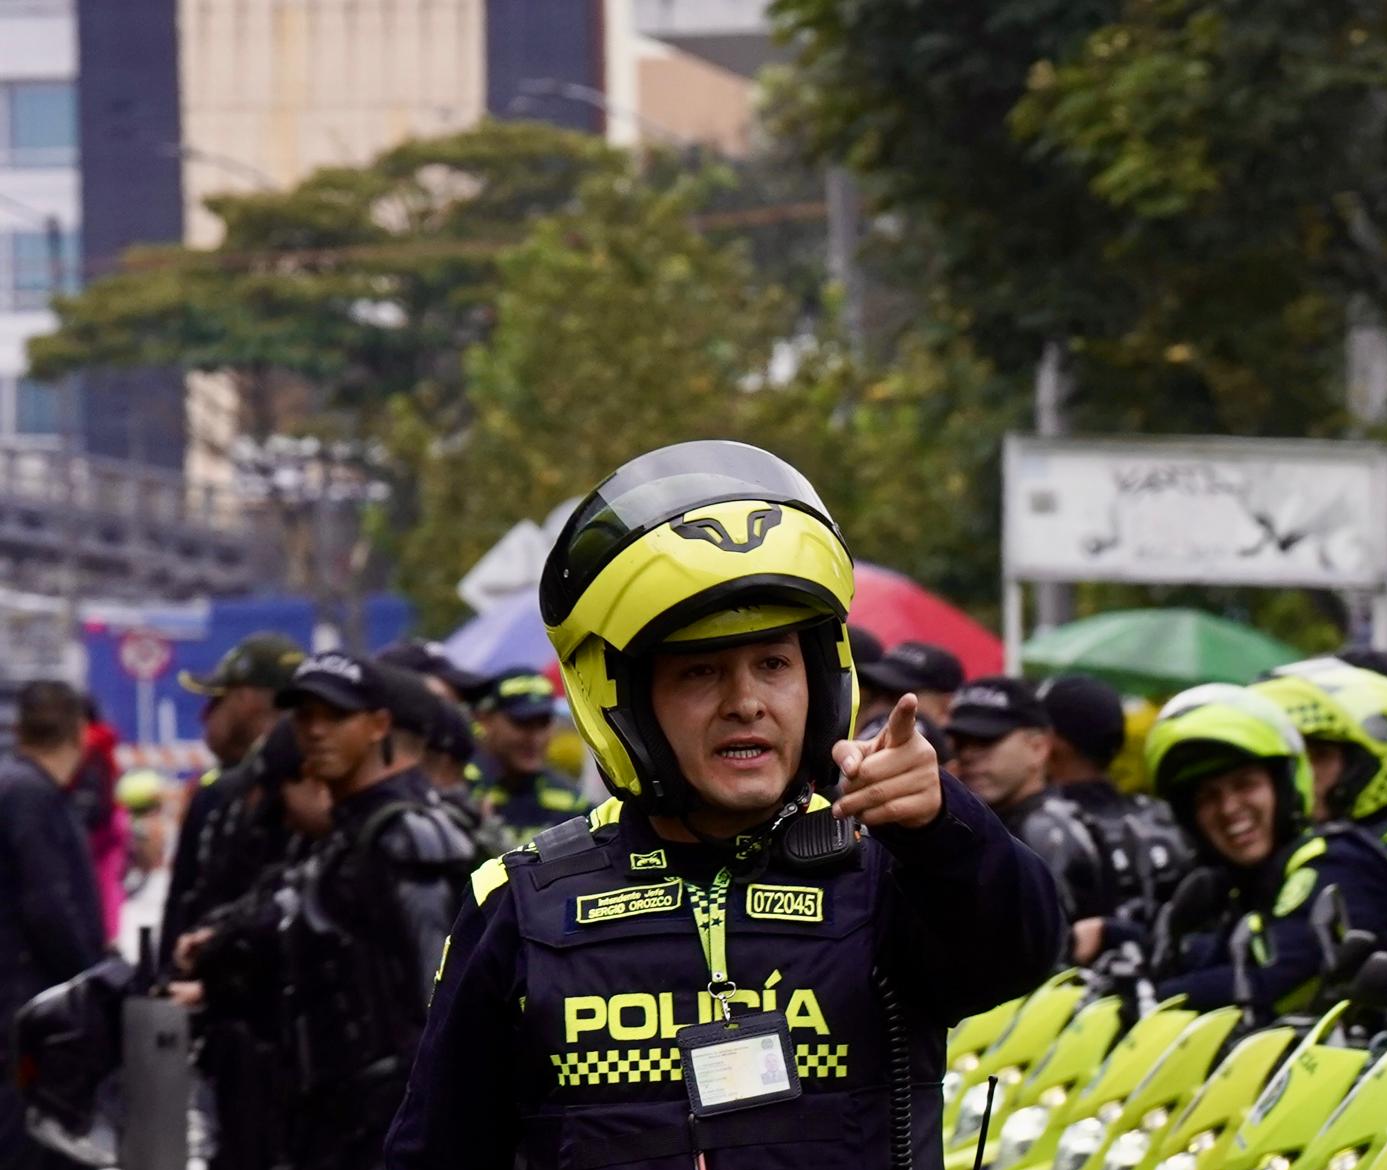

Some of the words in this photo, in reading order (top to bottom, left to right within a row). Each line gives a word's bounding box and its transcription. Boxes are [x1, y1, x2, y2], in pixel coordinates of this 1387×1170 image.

[589, 903, 625, 918] SERGIO
[629, 896, 672, 911] OROZCO
[754, 891, 816, 915] 072045
